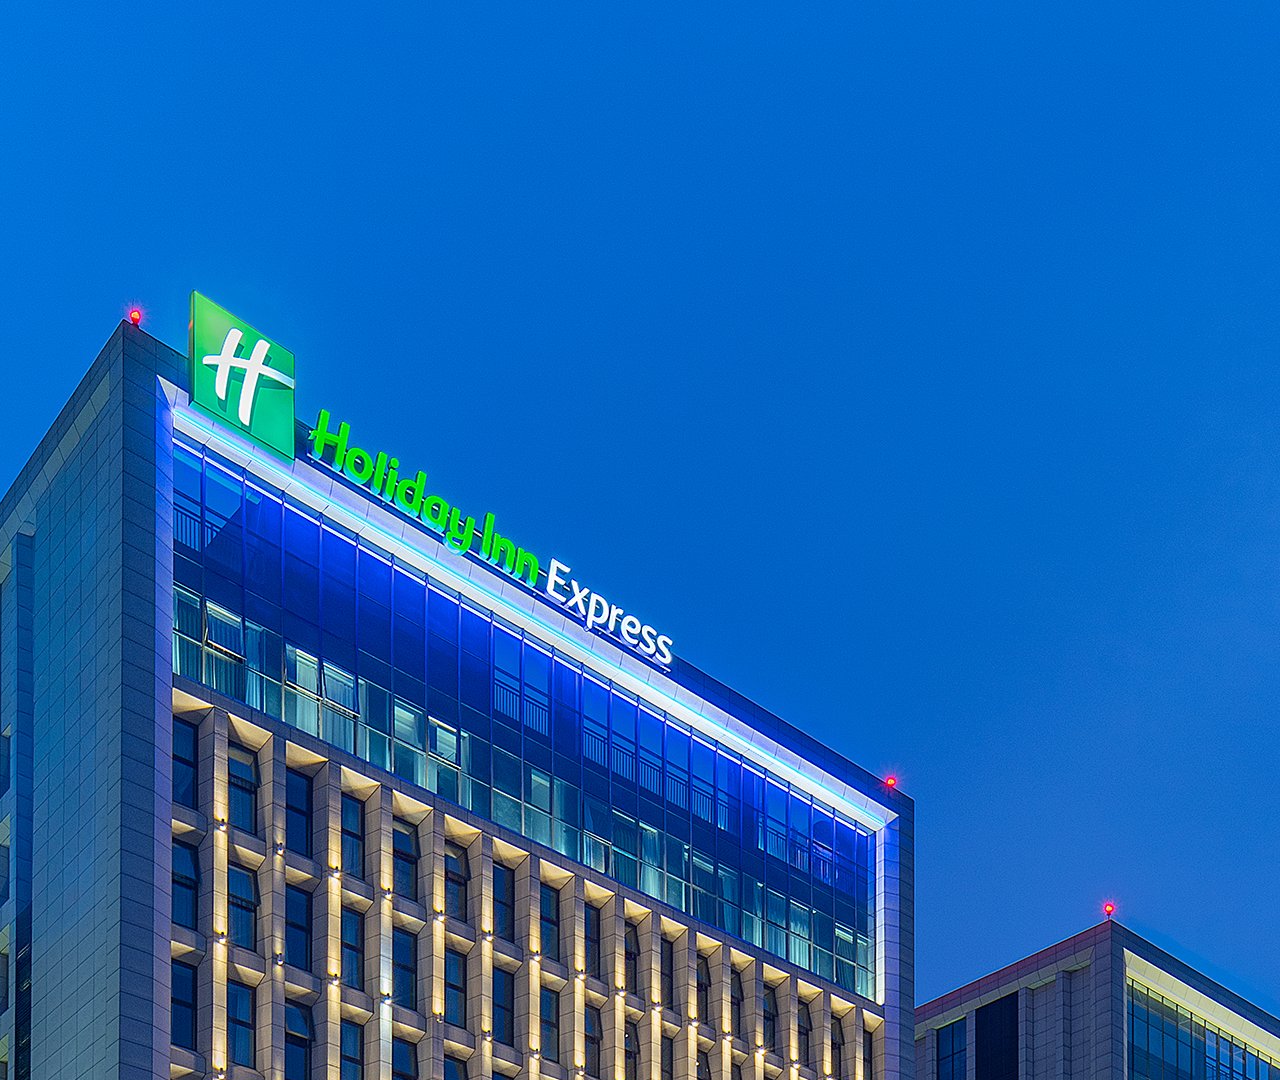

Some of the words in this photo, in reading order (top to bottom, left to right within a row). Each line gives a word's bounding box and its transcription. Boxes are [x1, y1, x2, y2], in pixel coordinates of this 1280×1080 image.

[310, 409, 475, 555] Holiday
[482, 512, 539, 587] Inn
[547, 558, 674, 666] Express
